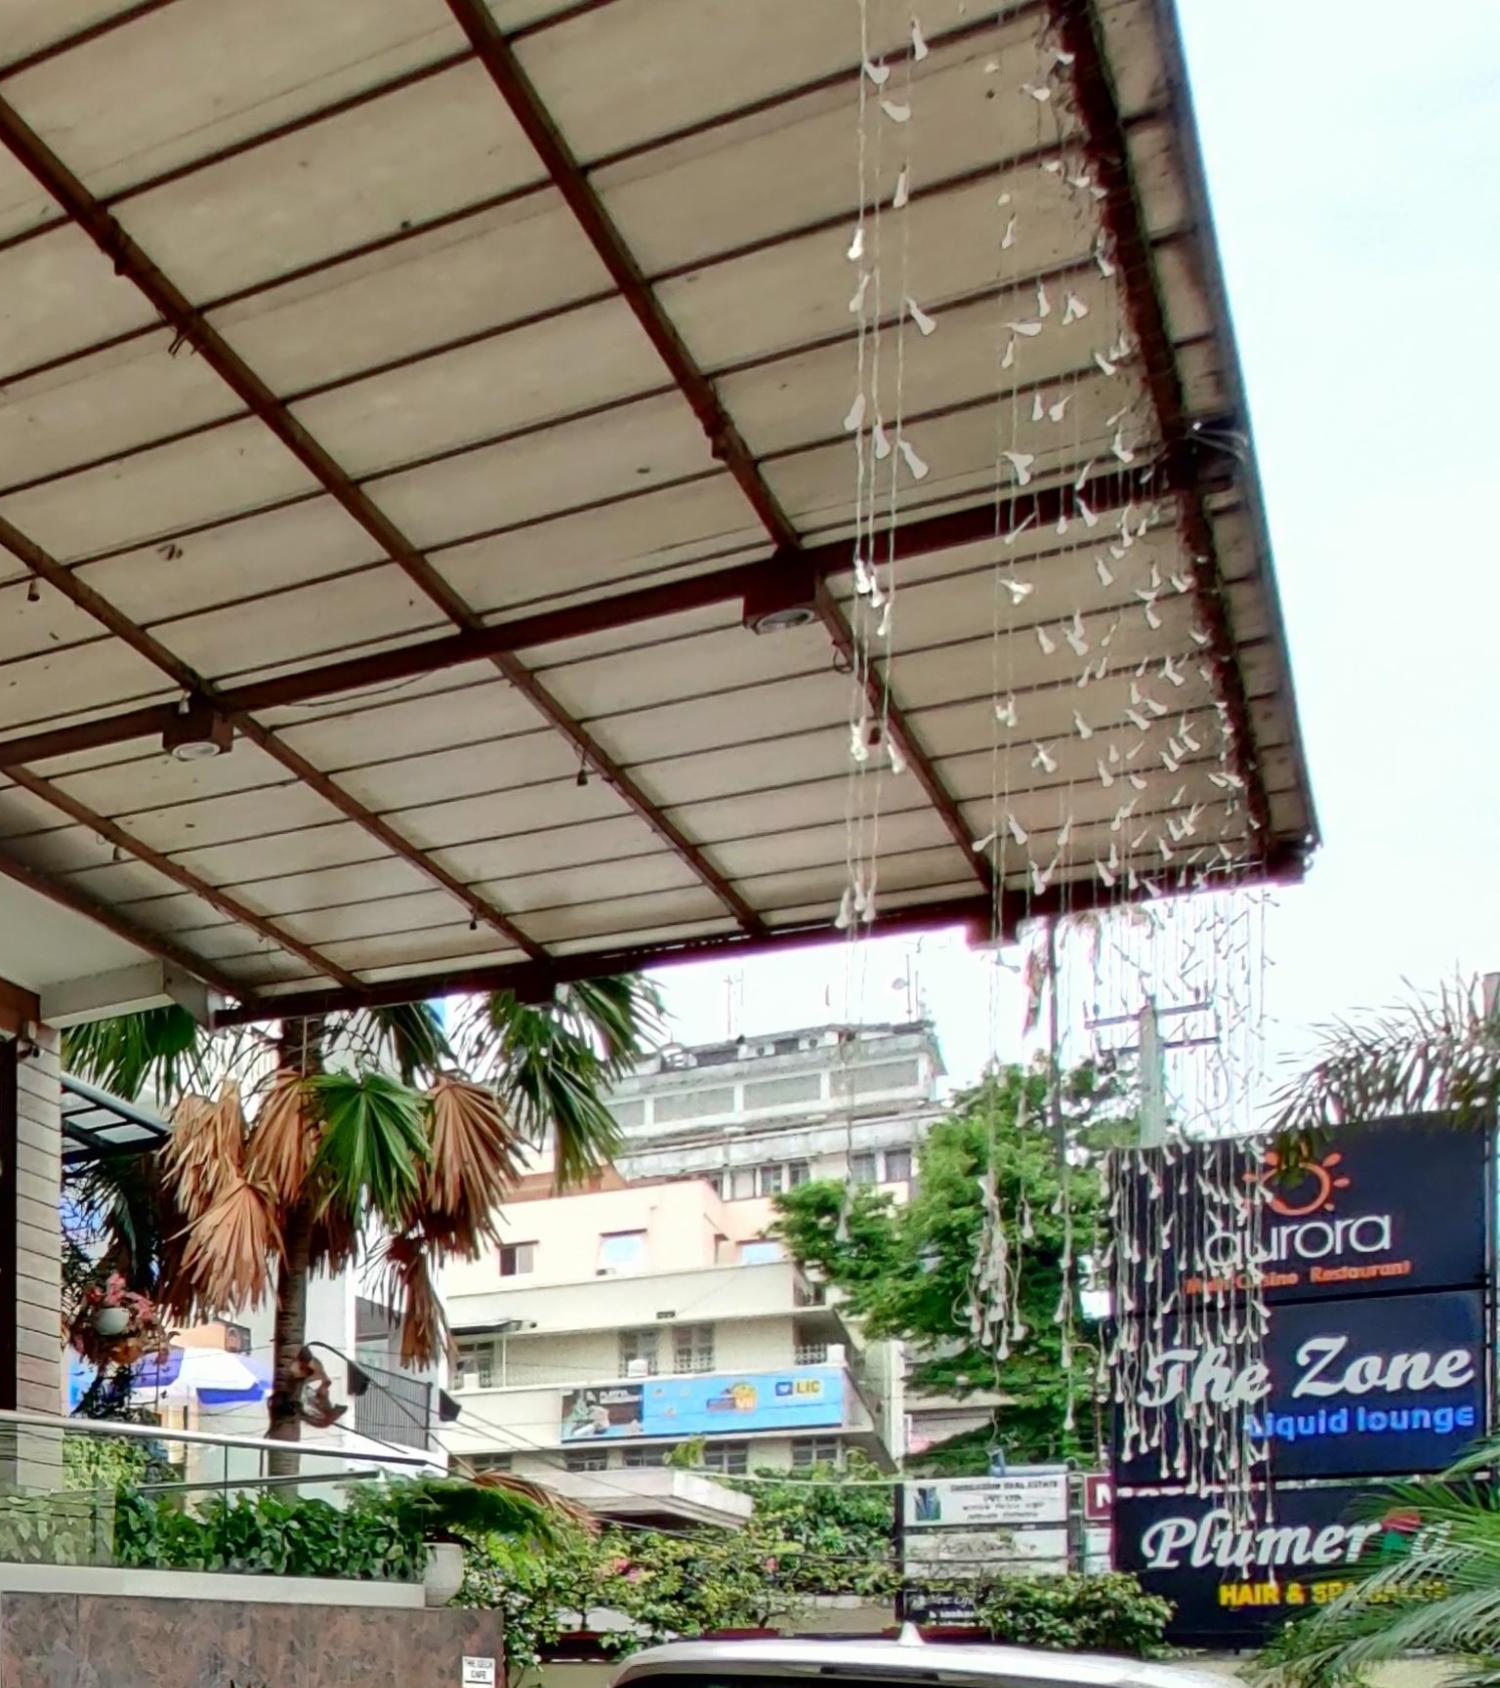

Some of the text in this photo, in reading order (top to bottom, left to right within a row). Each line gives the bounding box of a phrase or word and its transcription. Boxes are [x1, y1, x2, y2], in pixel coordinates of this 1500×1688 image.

[1204, 1214, 1391, 1267] aurora
[1310, 1260, 1412, 1283] Restaurant
[1137, 1335, 1475, 1408] The Zone
[1357, 1404, 1475, 1434] lounge
[1219, 1583, 1279, 1607] HAIR
[1286, 1584, 1304, 1606] &
